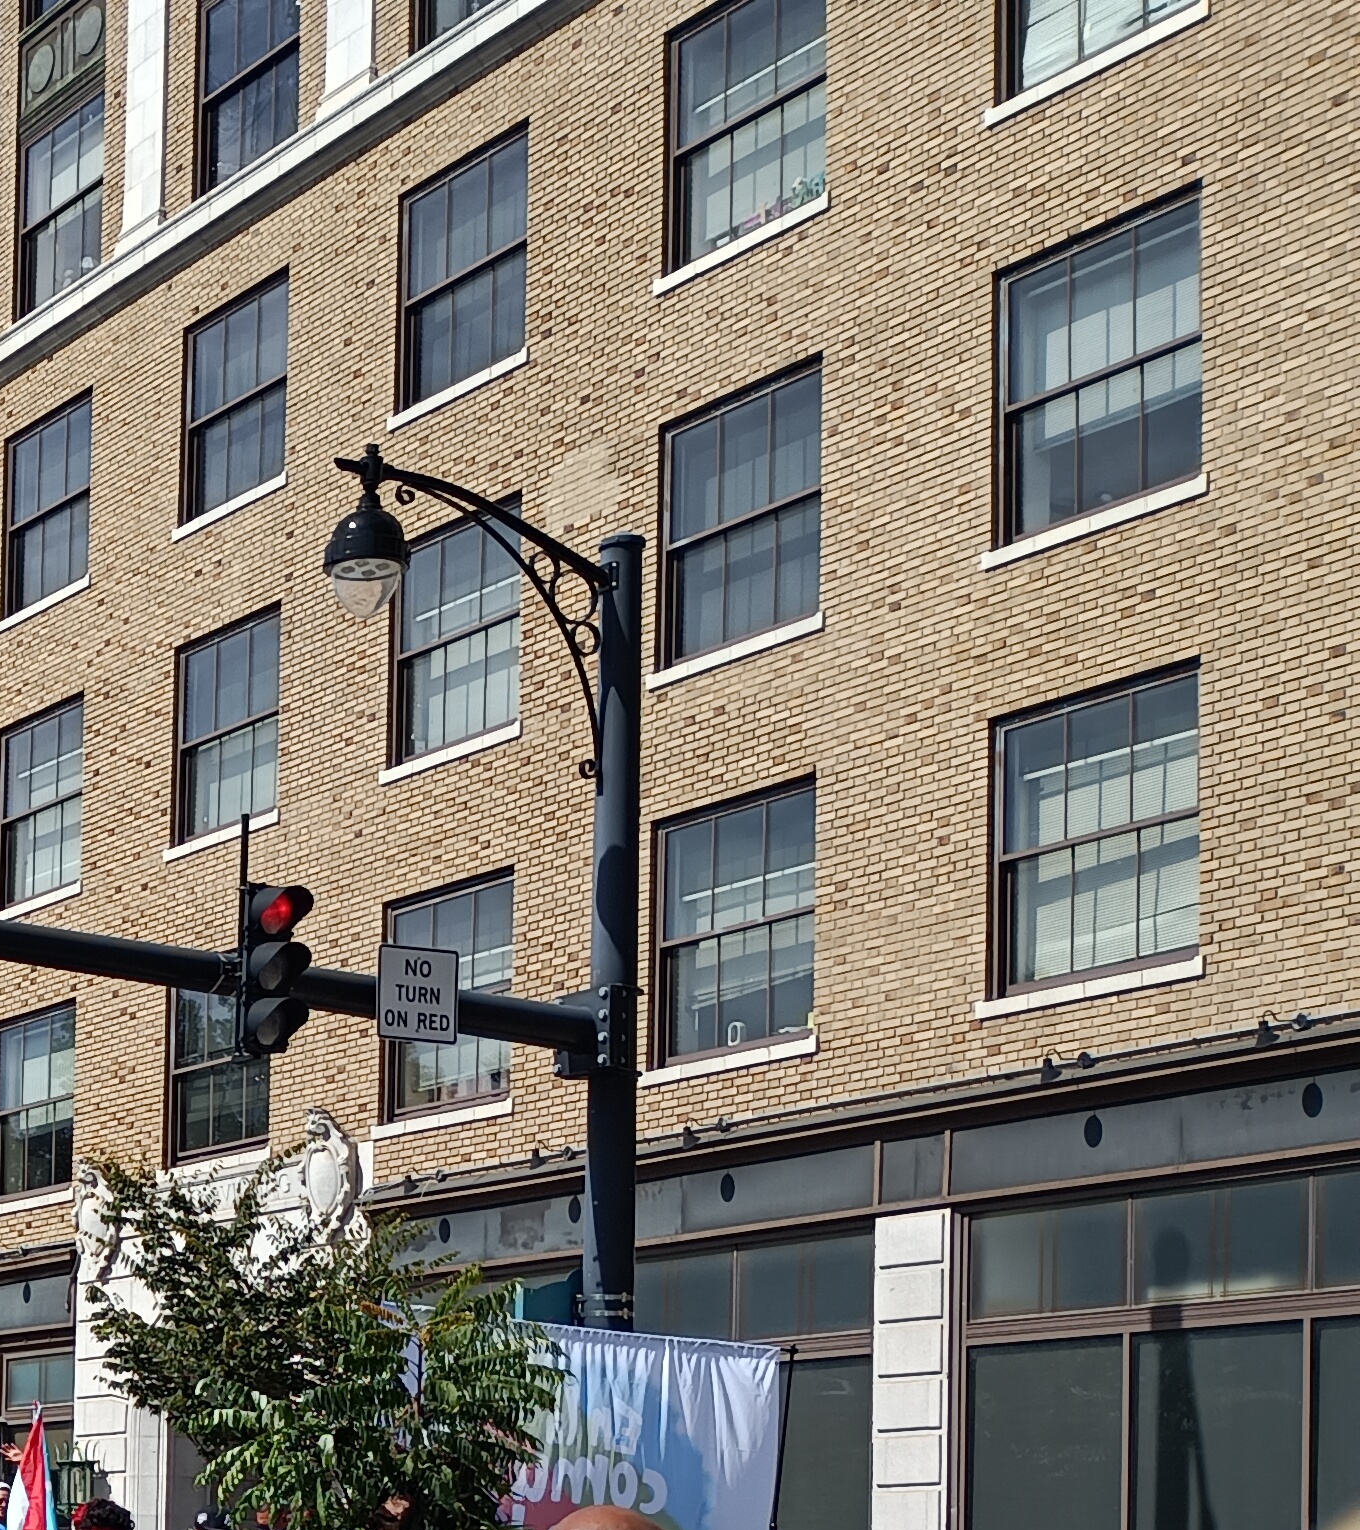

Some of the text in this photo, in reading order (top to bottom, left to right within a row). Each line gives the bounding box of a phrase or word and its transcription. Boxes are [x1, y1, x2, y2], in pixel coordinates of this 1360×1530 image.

[405, 959, 432, 978] NO
[395, 984, 440, 1005] TURN
[384, 1009, 450, 1032] ON RED
